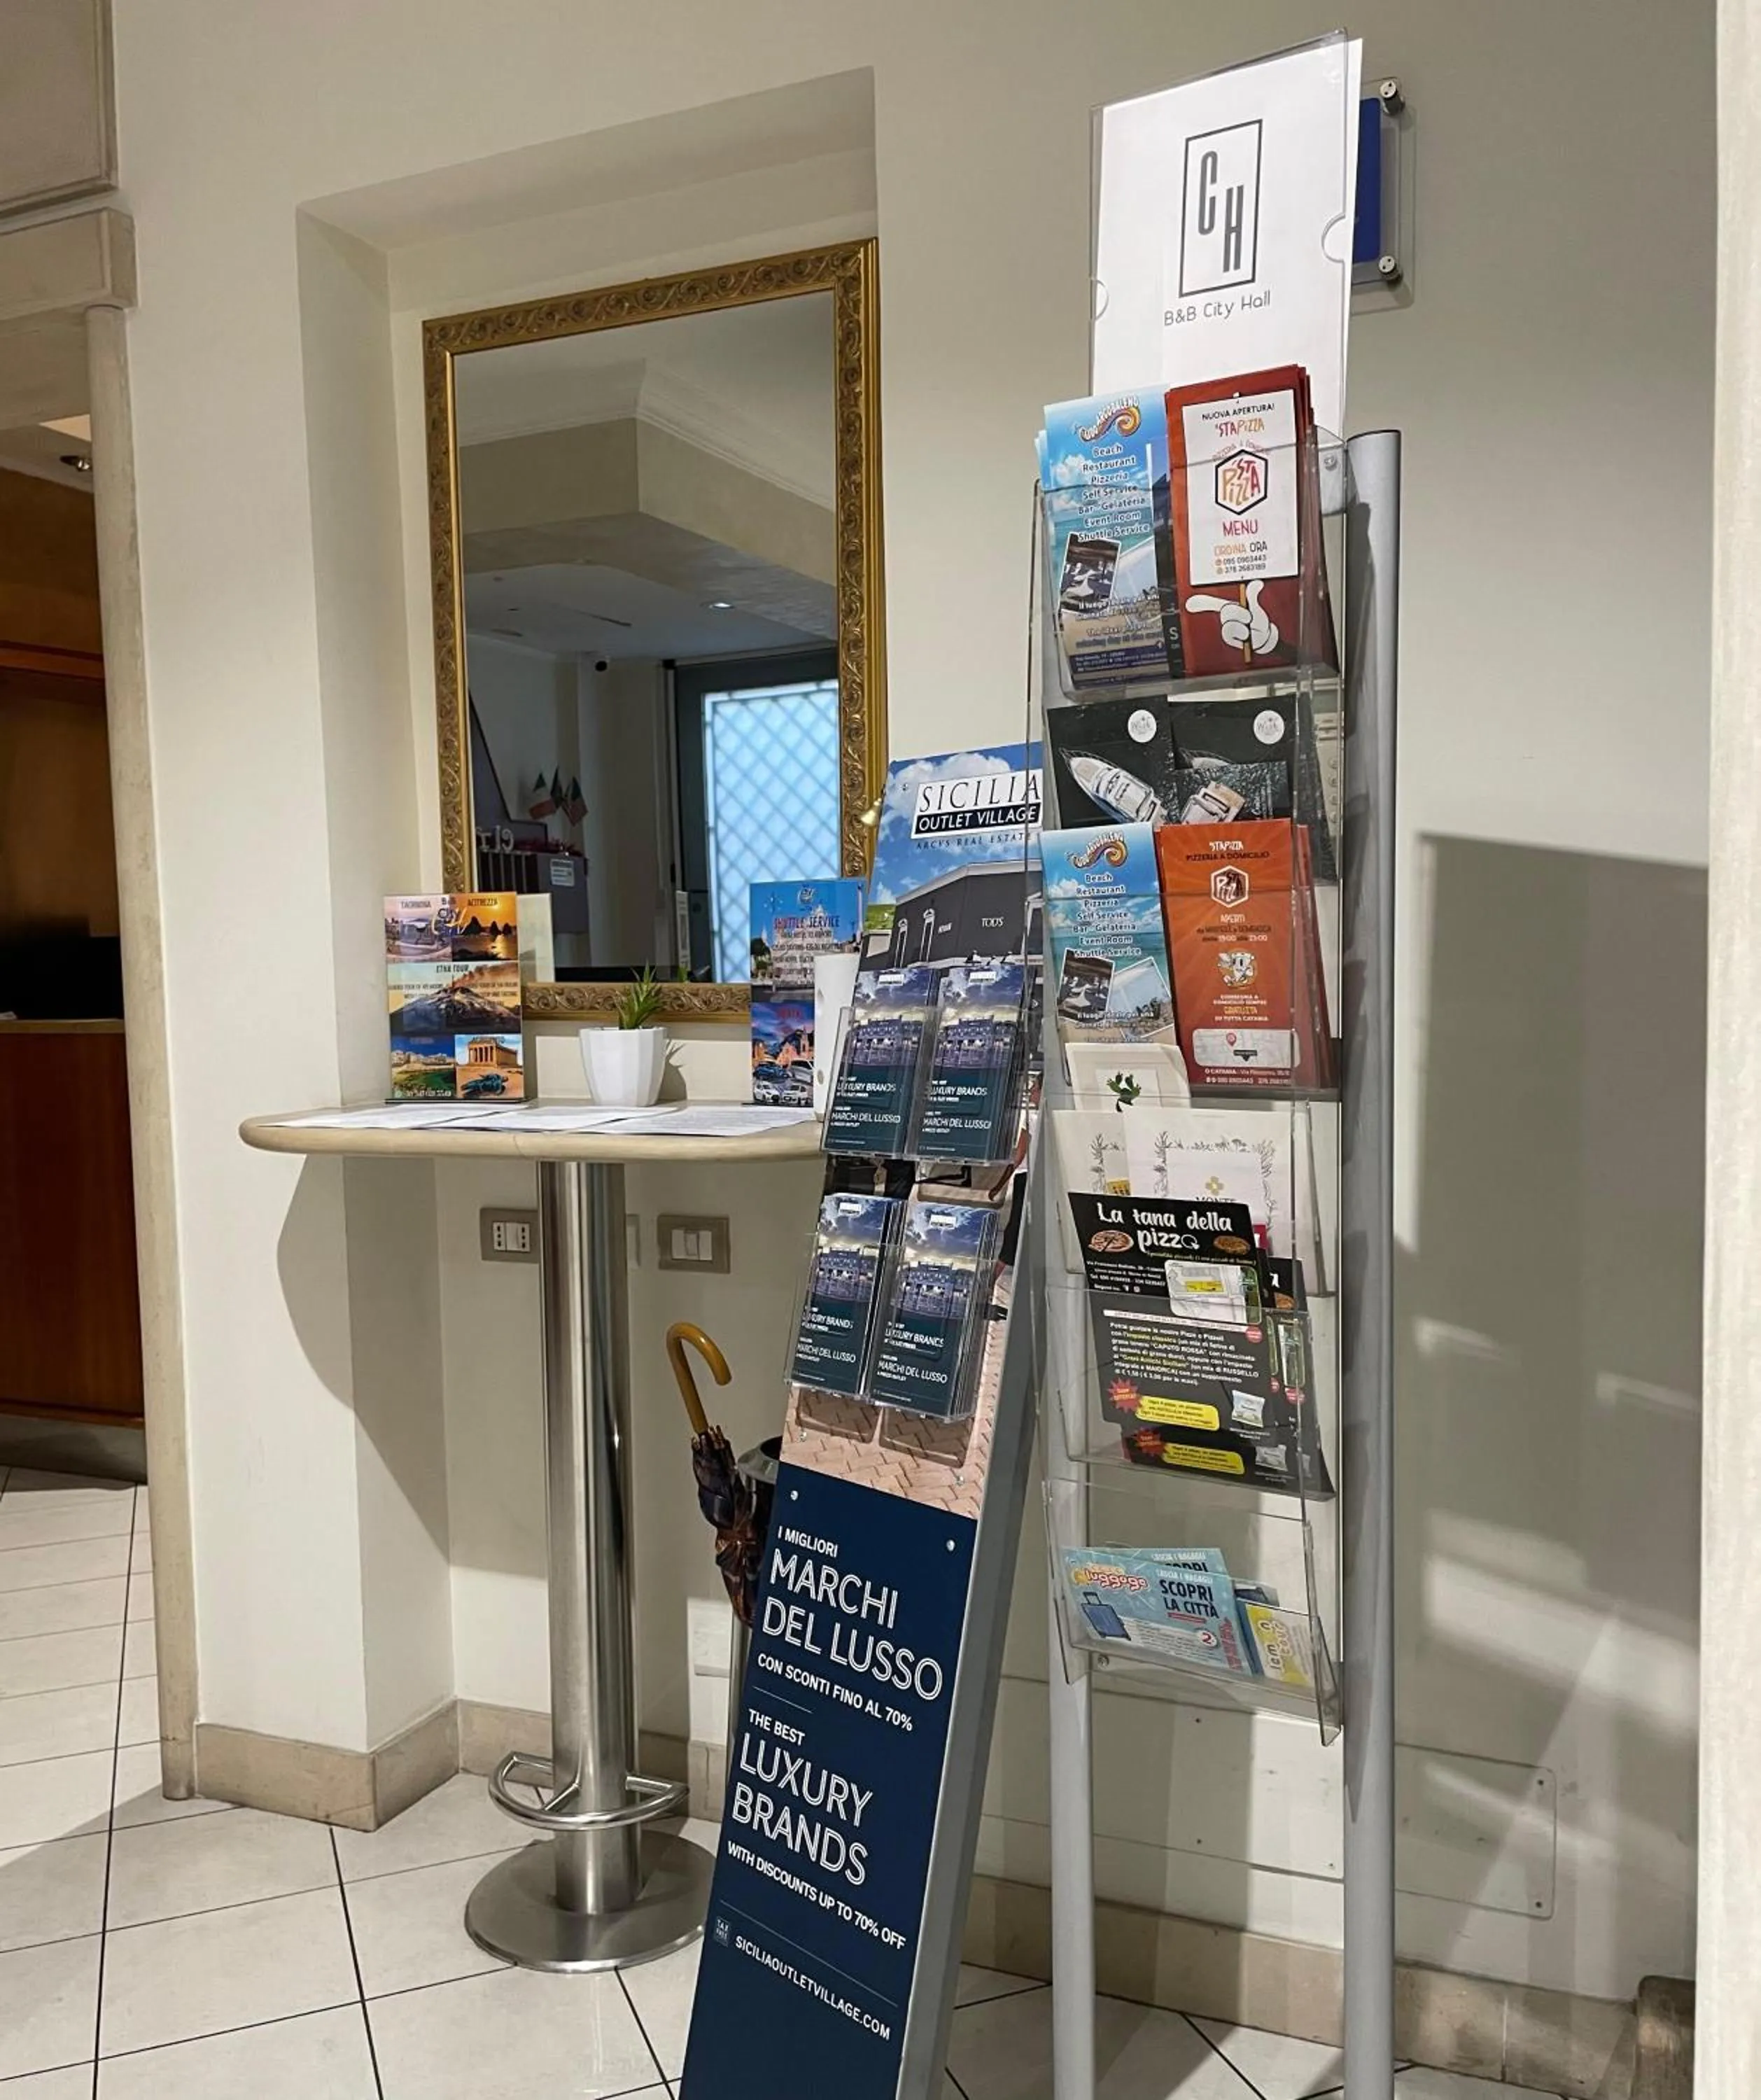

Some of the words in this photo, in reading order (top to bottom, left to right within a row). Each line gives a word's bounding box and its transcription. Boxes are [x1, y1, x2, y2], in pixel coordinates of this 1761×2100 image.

[1164, 306, 1196, 326] B&B
[1203, 301, 1234, 319] City
[1241, 291, 1271, 310] Hall
[1202, 410, 1230, 421] NUOVA
[1233, 402, 1275, 416] APERTURA!
[1093, 444, 1123, 456] Beach
[1083, 457, 1135, 472] Restaurant
[1091, 472, 1128, 484] Pizzeria
[1083, 489, 1101, 499] Self
[1104, 484, 1138, 496] Service
[1079, 505, 1094, 514] Bar
[1102, 498, 1145, 510] Gelateria
[1085, 516, 1111, 527] Event
[1114, 512, 1140, 522] Room
[1223, 519, 1258, 536] MENU
[1079, 530, 1112, 542] Shuttle
[1115, 524, 1149, 536] Service
[1249, 541, 1268, 552] ORA
[920, 774, 1041, 813] SICILIA
[919, 813, 971, 831] OUTLET
[978, 806, 1037, 825] VILLAGE
[957, 837, 982, 847] REAL
[1086, 874, 1112, 883] Beach
[1076, 885, 1125, 895] Restaurant
[1084, 899, 1119, 909] Pizzeria
[1077, 912, 1094, 920] Self
[1073, 925, 1088, 933] Bar
[1095, 923, 1136, 932] Gelateria
[1080, 937, 1104, 946] Event
[1107, 936, 1132, 944] Room
[1074, 949, 1106, 958] Shuttle
[1108, 947, 1141, 956] Service
[1097, 1203, 1124, 1224] La
[1132, 1209, 1177, 1228] tana
[1186, 1211, 1233, 1232] della
[778, 1526, 783, 1539] I
[785, 1527, 838, 1558] MIGLIORI
[769, 1548, 898, 1630] MARCHI
[1159, 1579, 1214, 1602] SCOPRI
[1164, 1597, 1180, 1611] LA
[1184, 1600, 1219, 1618] CITTÀ
[762, 1596, 822, 1655] DEL
[829, 1622, 943, 1700] LUSSO
[757, 1653, 783, 1674] CON
[785, 1665, 831, 1695] SCONTI
[832, 1685, 863, 1709] FINO
[864, 1699, 883, 1718] AL
[885, 1707, 913, 1732] 70%
[748, 1709, 771, 1731] THE
[774, 1721, 806, 1746] BEST
[740, 1732, 874, 1827] LUXURY
[732, 1782, 869, 1886] BRANDS
[727, 1840, 755, 1868] WITH
[755, 1856, 818, 1902] DISCOUNTS
[819, 1891, 836, 1910] UP
[836, 1900, 853, 1920] TO
[855, 1910, 879, 1937] 70%
[881, 1927, 906, 1950] OFF
[735, 1935, 891, 2041] SICILIAOUTLETVILLAGE.COM
